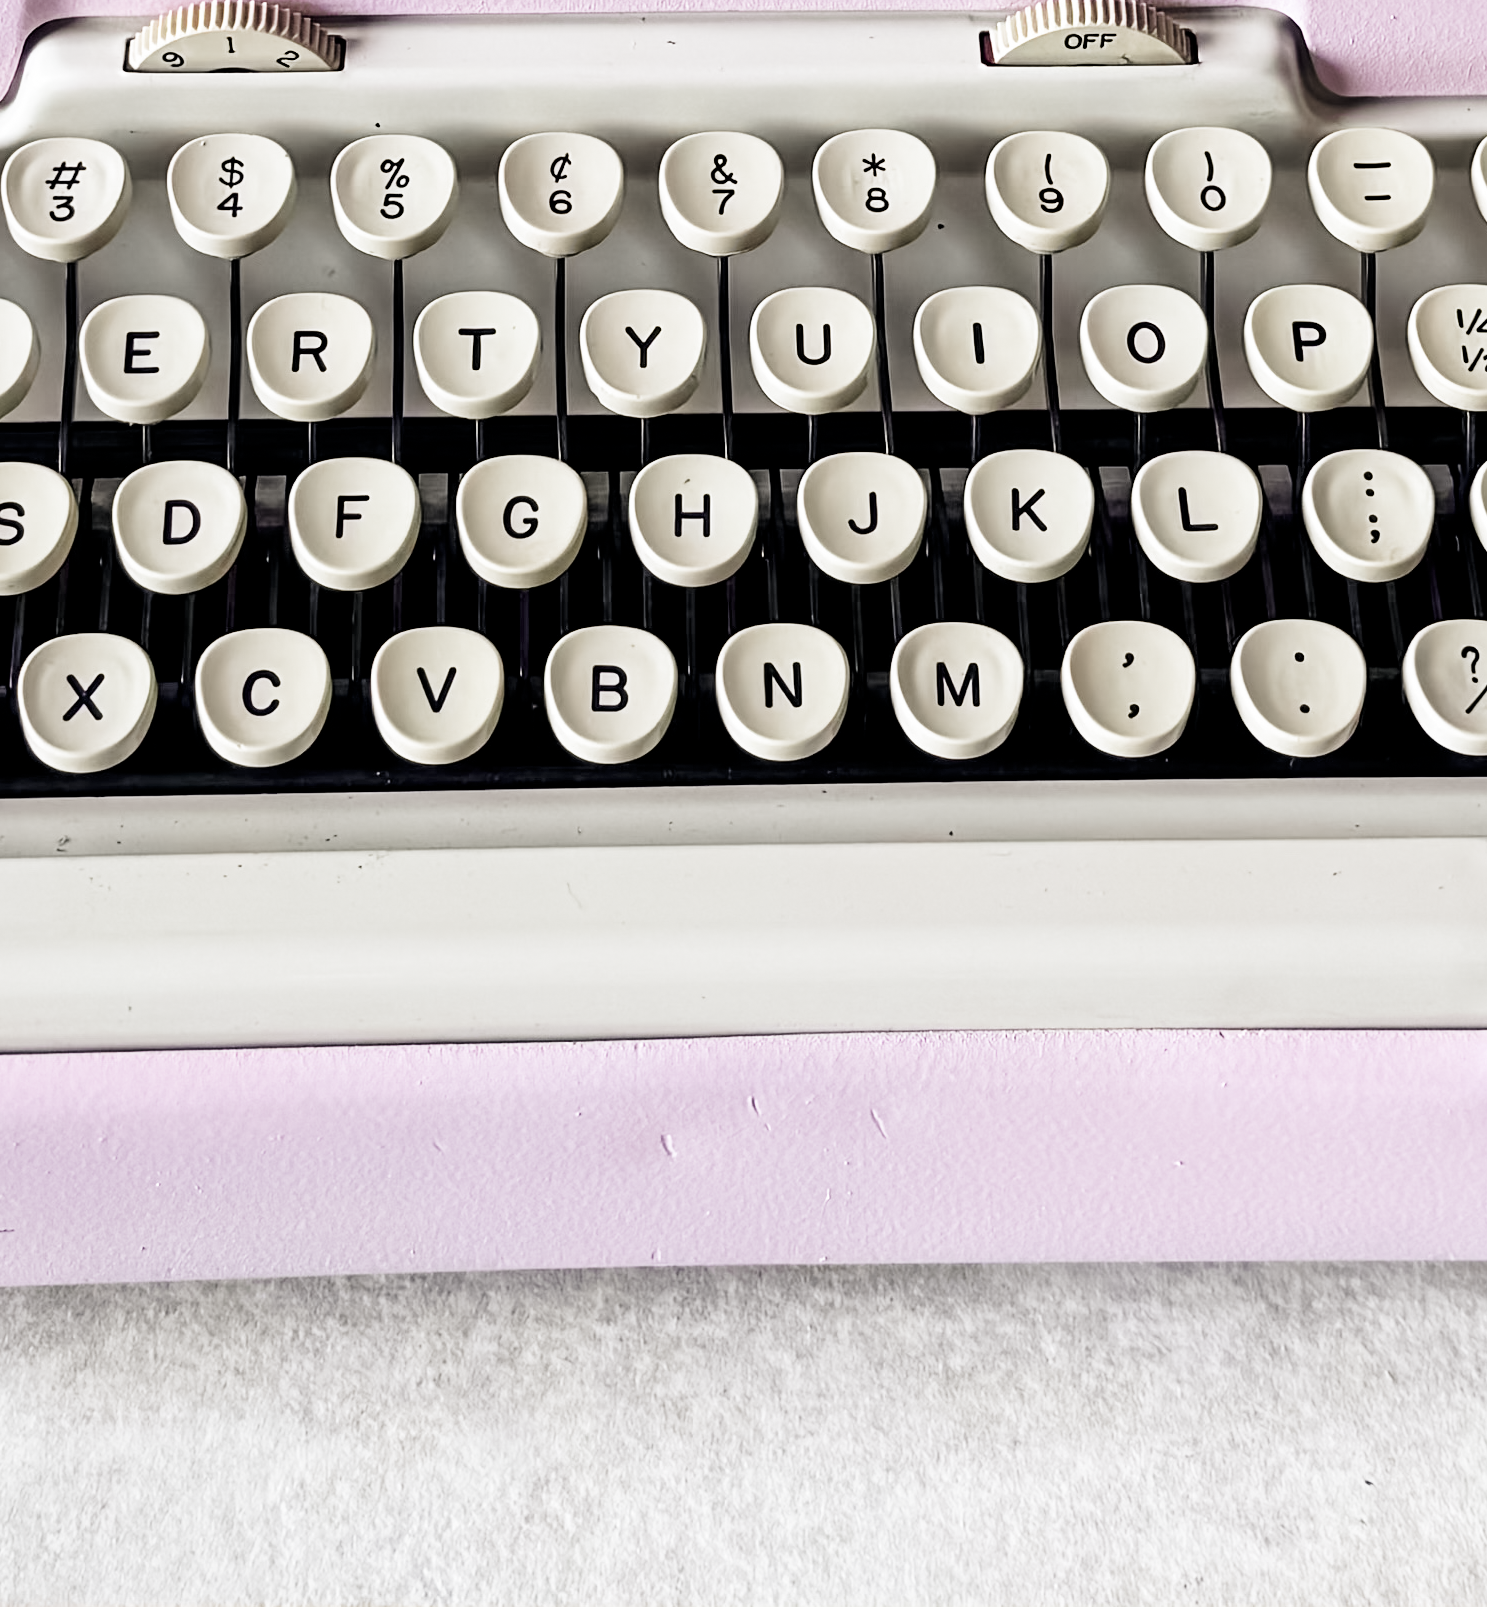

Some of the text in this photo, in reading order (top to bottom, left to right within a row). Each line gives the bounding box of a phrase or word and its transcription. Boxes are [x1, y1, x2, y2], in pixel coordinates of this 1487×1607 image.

[226, 36, 236, 54] 1
[275, 50, 300, 69] 2
[1064, 33, 1117, 50] OFF
[45, 161, 87, 190] #
[218, 156, 244, 189] $
[379, 157, 410, 190] %
[710, 153, 738, 185] &
[49, 195, 75, 222] 3
[216, 192, 244, 218] 4
[379, 193, 405, 220] 5
[548, 189, 573, 215] 6
[711, 189, 735, 216] 7
[865, 187, 890, 213] 8
[1038, 187, 1064, 214] 9
[1200, 185, 1227, 212] 0
[123, 331, 160, 374] E
[291, 330, 328, 373] R
[458, 328, 497, 371] T
[624, 325, 662, 369] Y
[795, 323, 832, 366] U
[972, 322, 985, 365] I
[1126, 321, 1166, 364] O
[1291, 321, 1327, 363] P
[162, 499, 201, 546] D
[335, 494, 370, 539] F
[502, 495, 539, 540] G
[674, 493, 711, 538] H
[847, 491, 878, 535] J
[1011, 487, 1048, 532] K
[1177, 486, 1219, 532] L
[763, 661, 803, 709] N
[936, 661, 981, 708] M
[1460, 645, 1480, 684] ?
[62, 673, 105, 722] X
[241, 669, 281, 717] C
[416, 666, 457, 714] V
[591, 664, 629, 713] B
